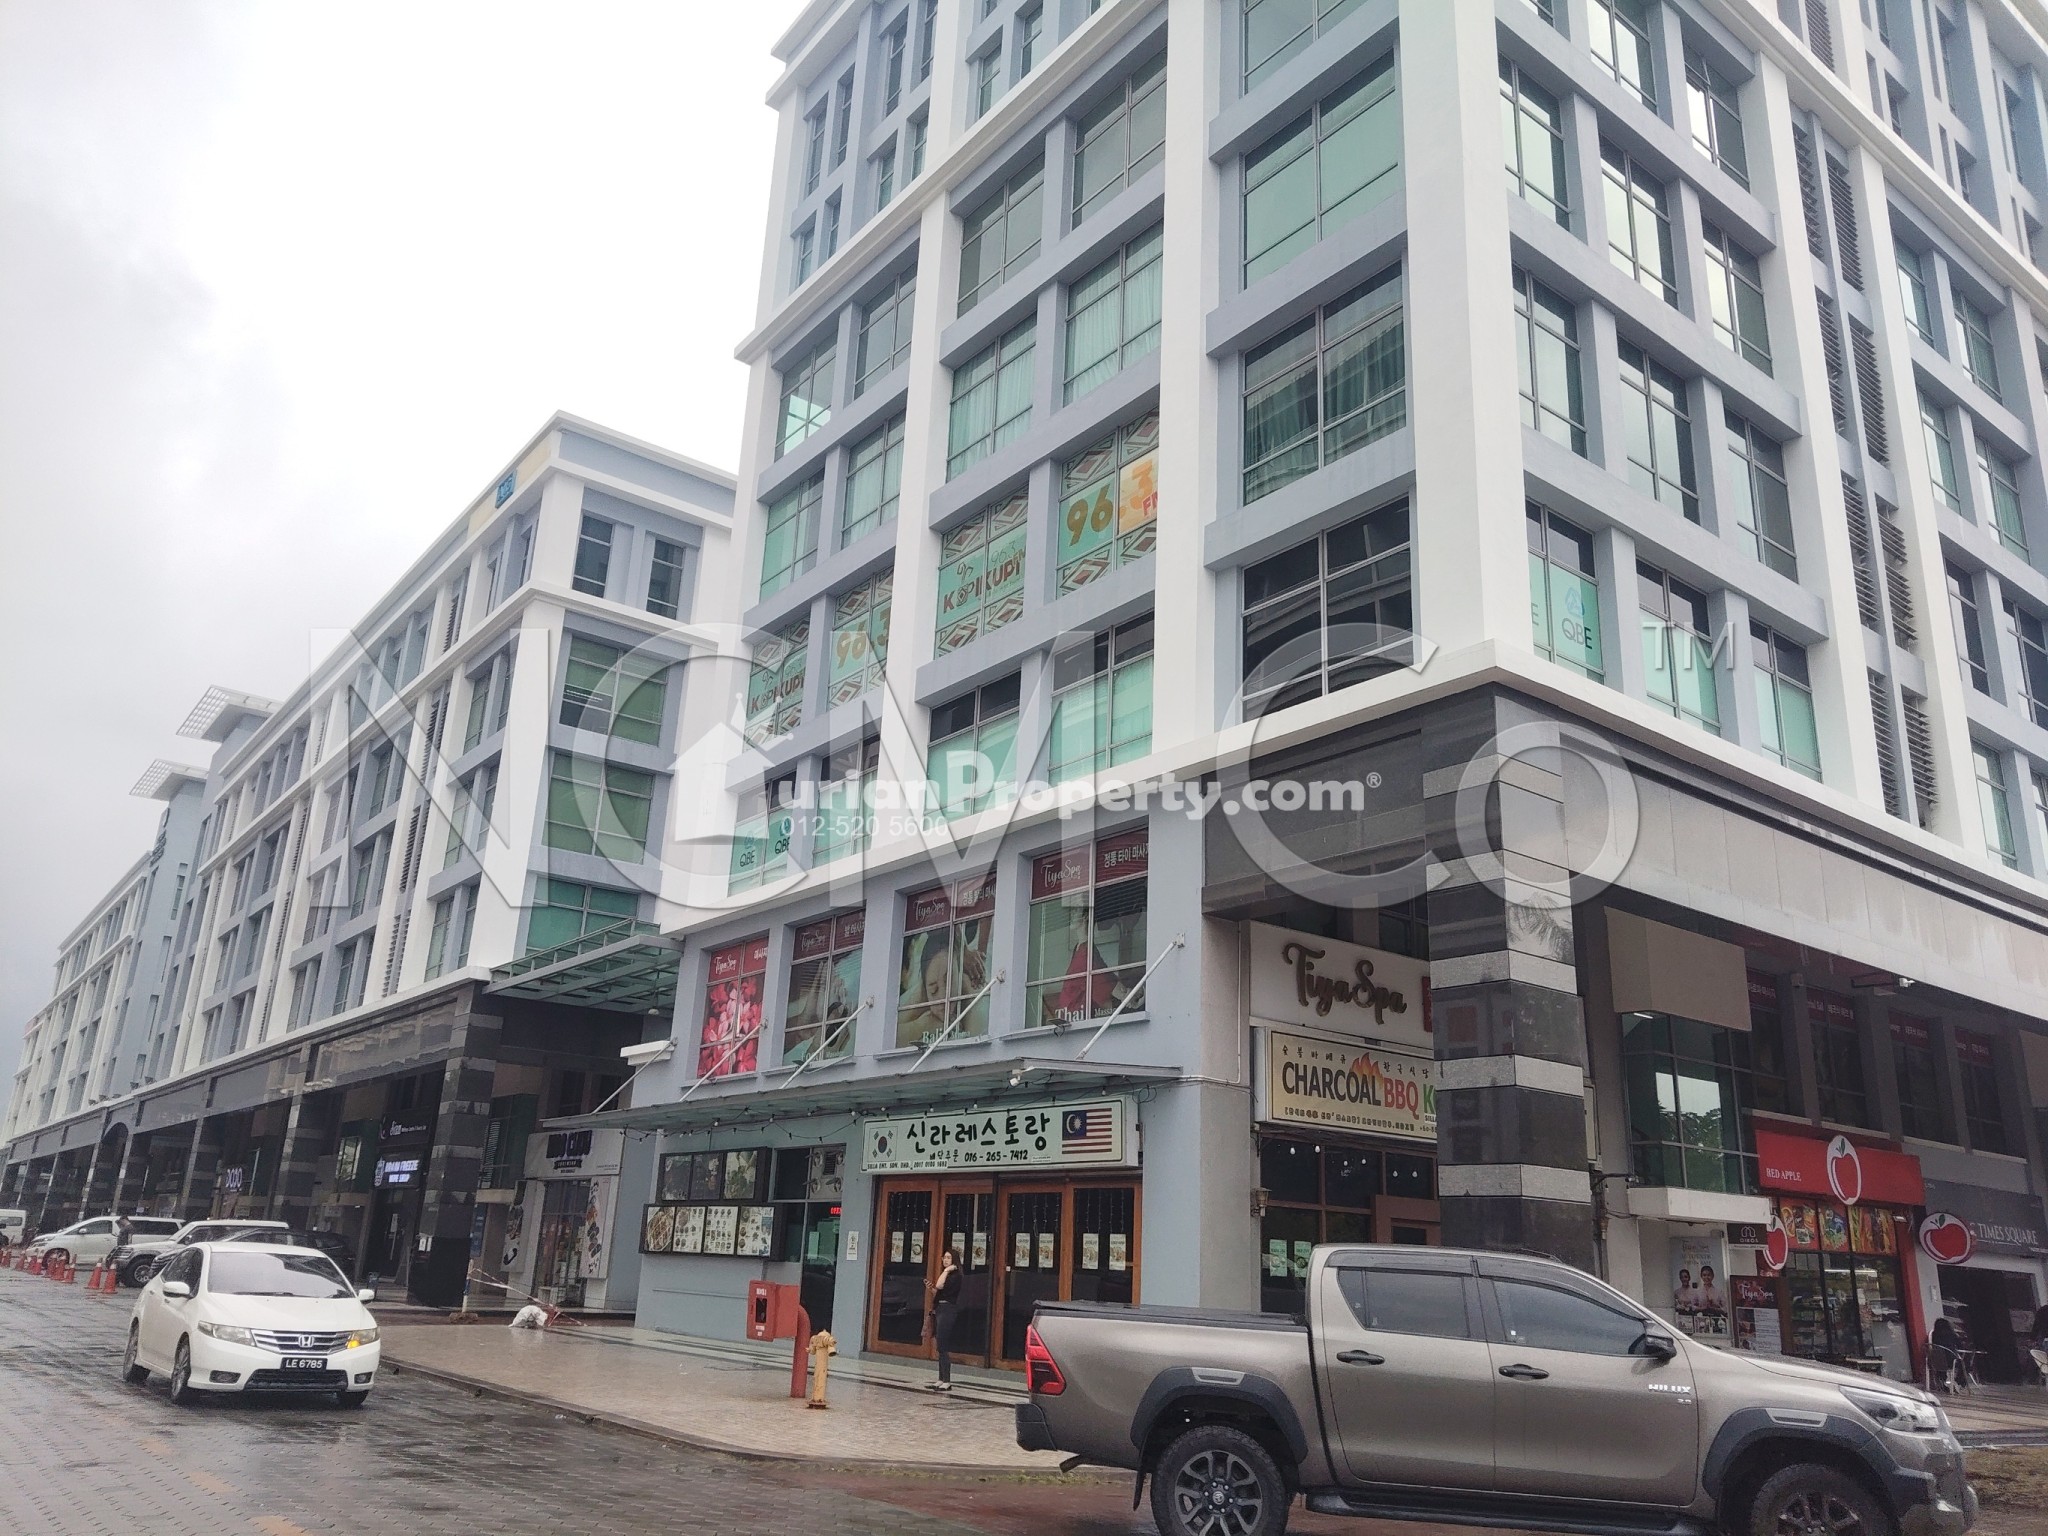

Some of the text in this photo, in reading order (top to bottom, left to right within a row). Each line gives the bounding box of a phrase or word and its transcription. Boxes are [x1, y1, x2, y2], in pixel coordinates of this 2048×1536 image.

[1561, 616, 1593, 650] QBE
[739, 849, 756, 867] QBE
[1104, 850, 1117, 868] 정통
[1054, 1004, 1117, 1023] Thai Massa
[1282, 1061, 1382, 1107] CHARCOAL
[1384, 1077, 1419, 1121] BBQ
[907, 1112, 1051, 1154] 신라레스토랑
[1766, 1167, 1802, 1182] RED APPLE
[1977, 1223, 2039, 1246] TIMES SQUARE
[285, 1359, 323, 1368] LE 6785
